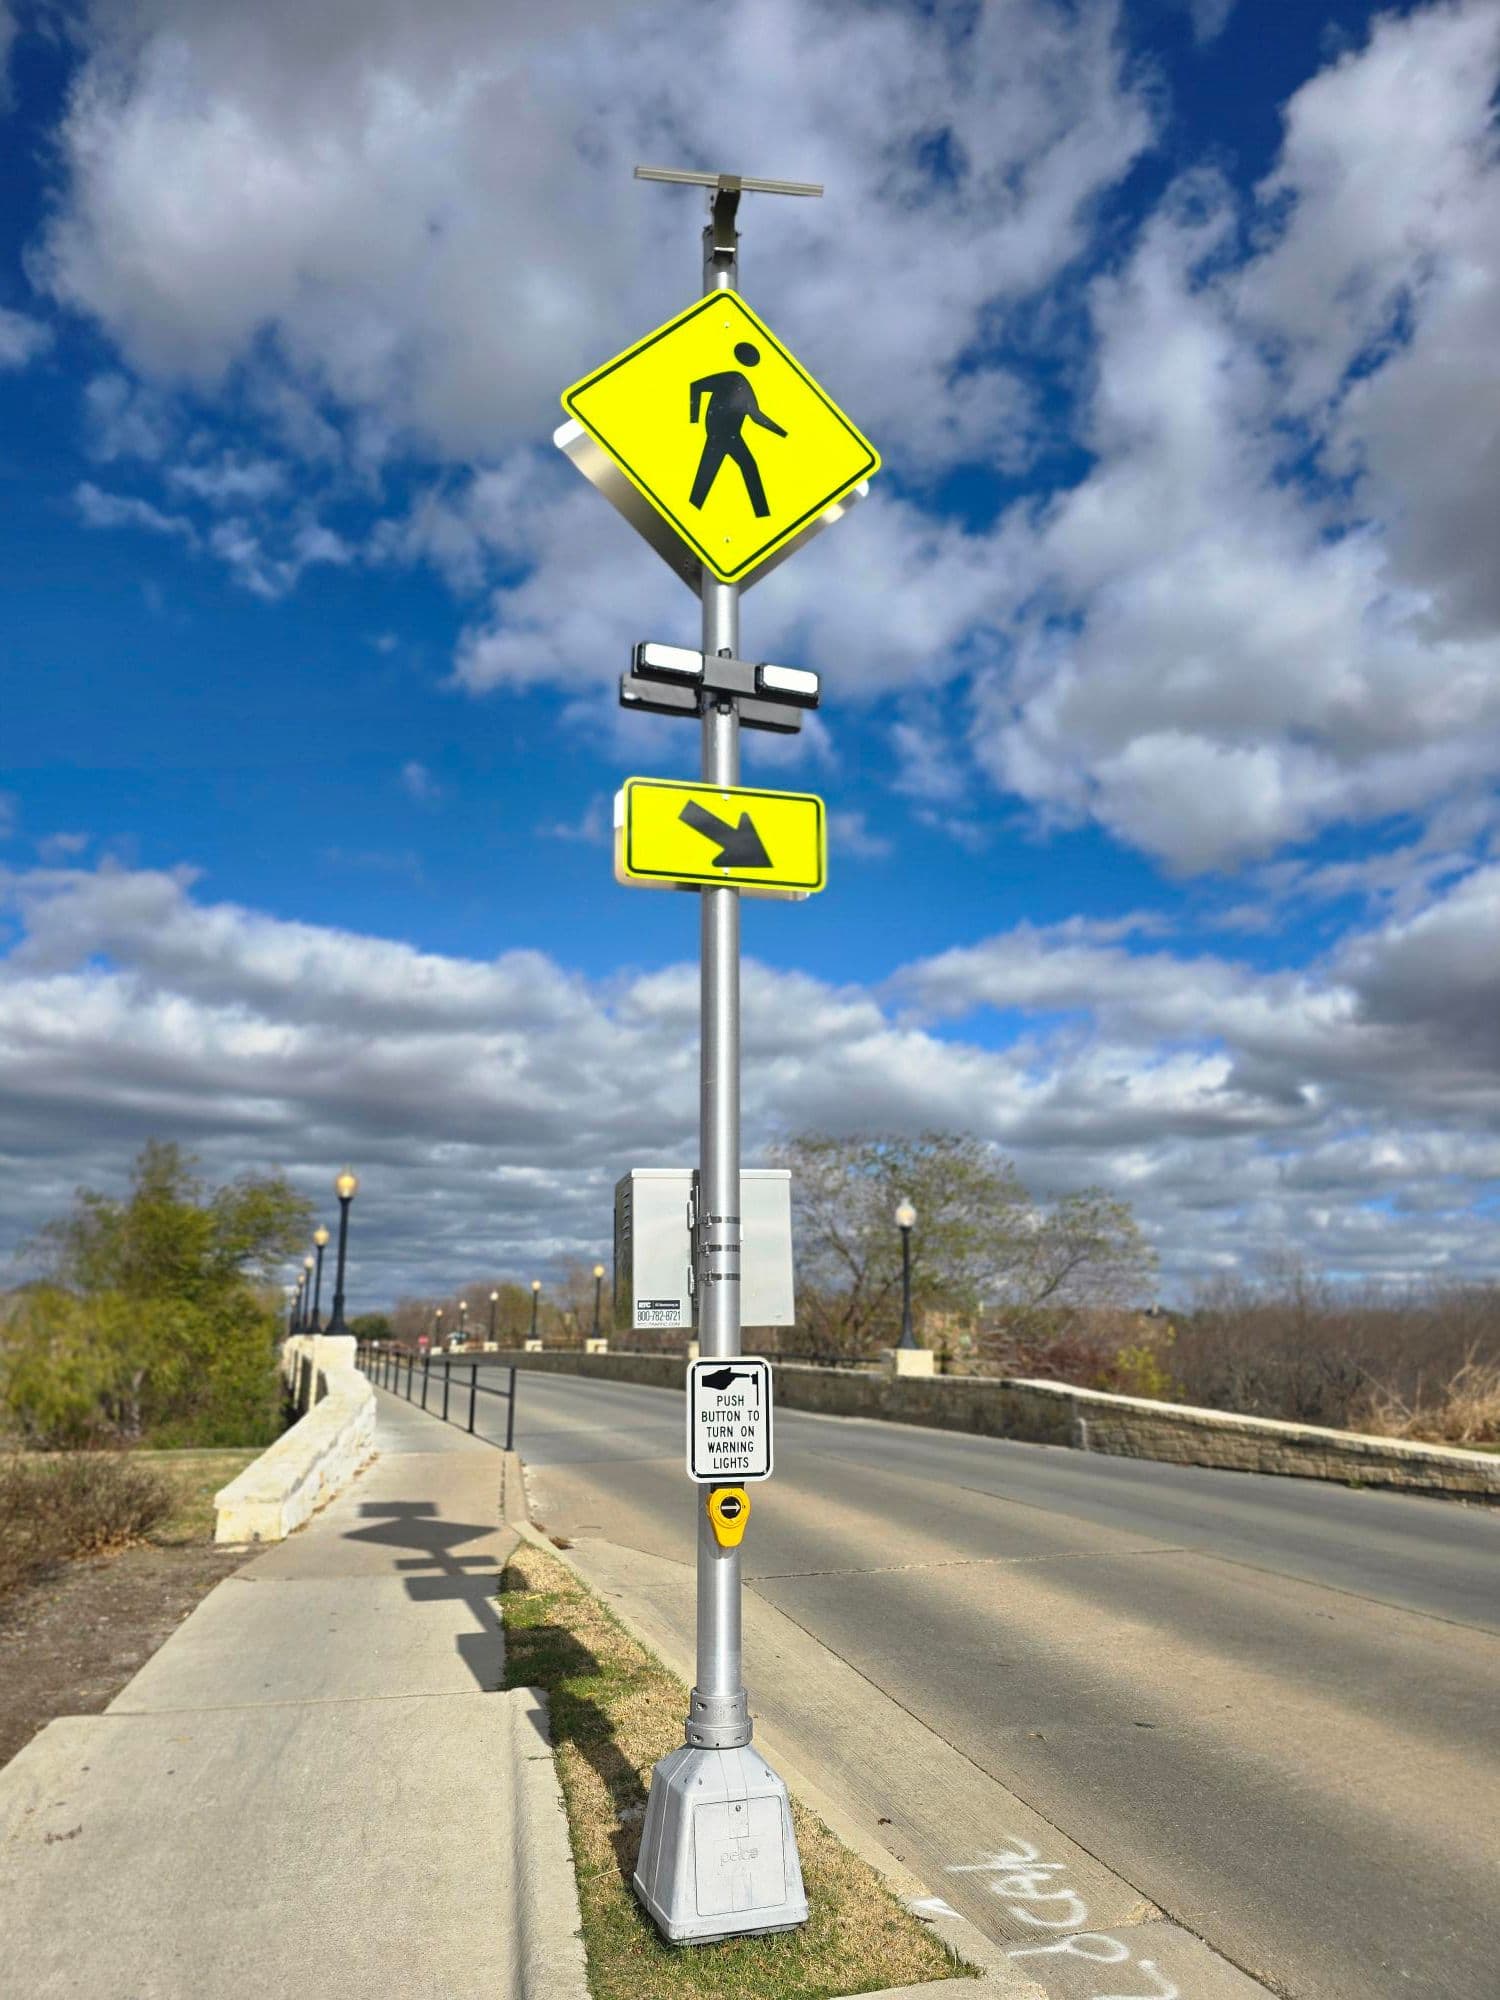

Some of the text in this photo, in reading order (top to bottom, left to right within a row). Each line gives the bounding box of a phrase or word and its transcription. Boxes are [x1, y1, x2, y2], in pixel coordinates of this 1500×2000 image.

[717, 1395, 744, 1406] PUSH
[701, 1410, 760, 1422] BUTTON TO
[706, 1425, 755, 1438] TURN ON
[707, 1441, 754, 1453] WARNING
[713, 1457, 749, 1469] LIGHTS
